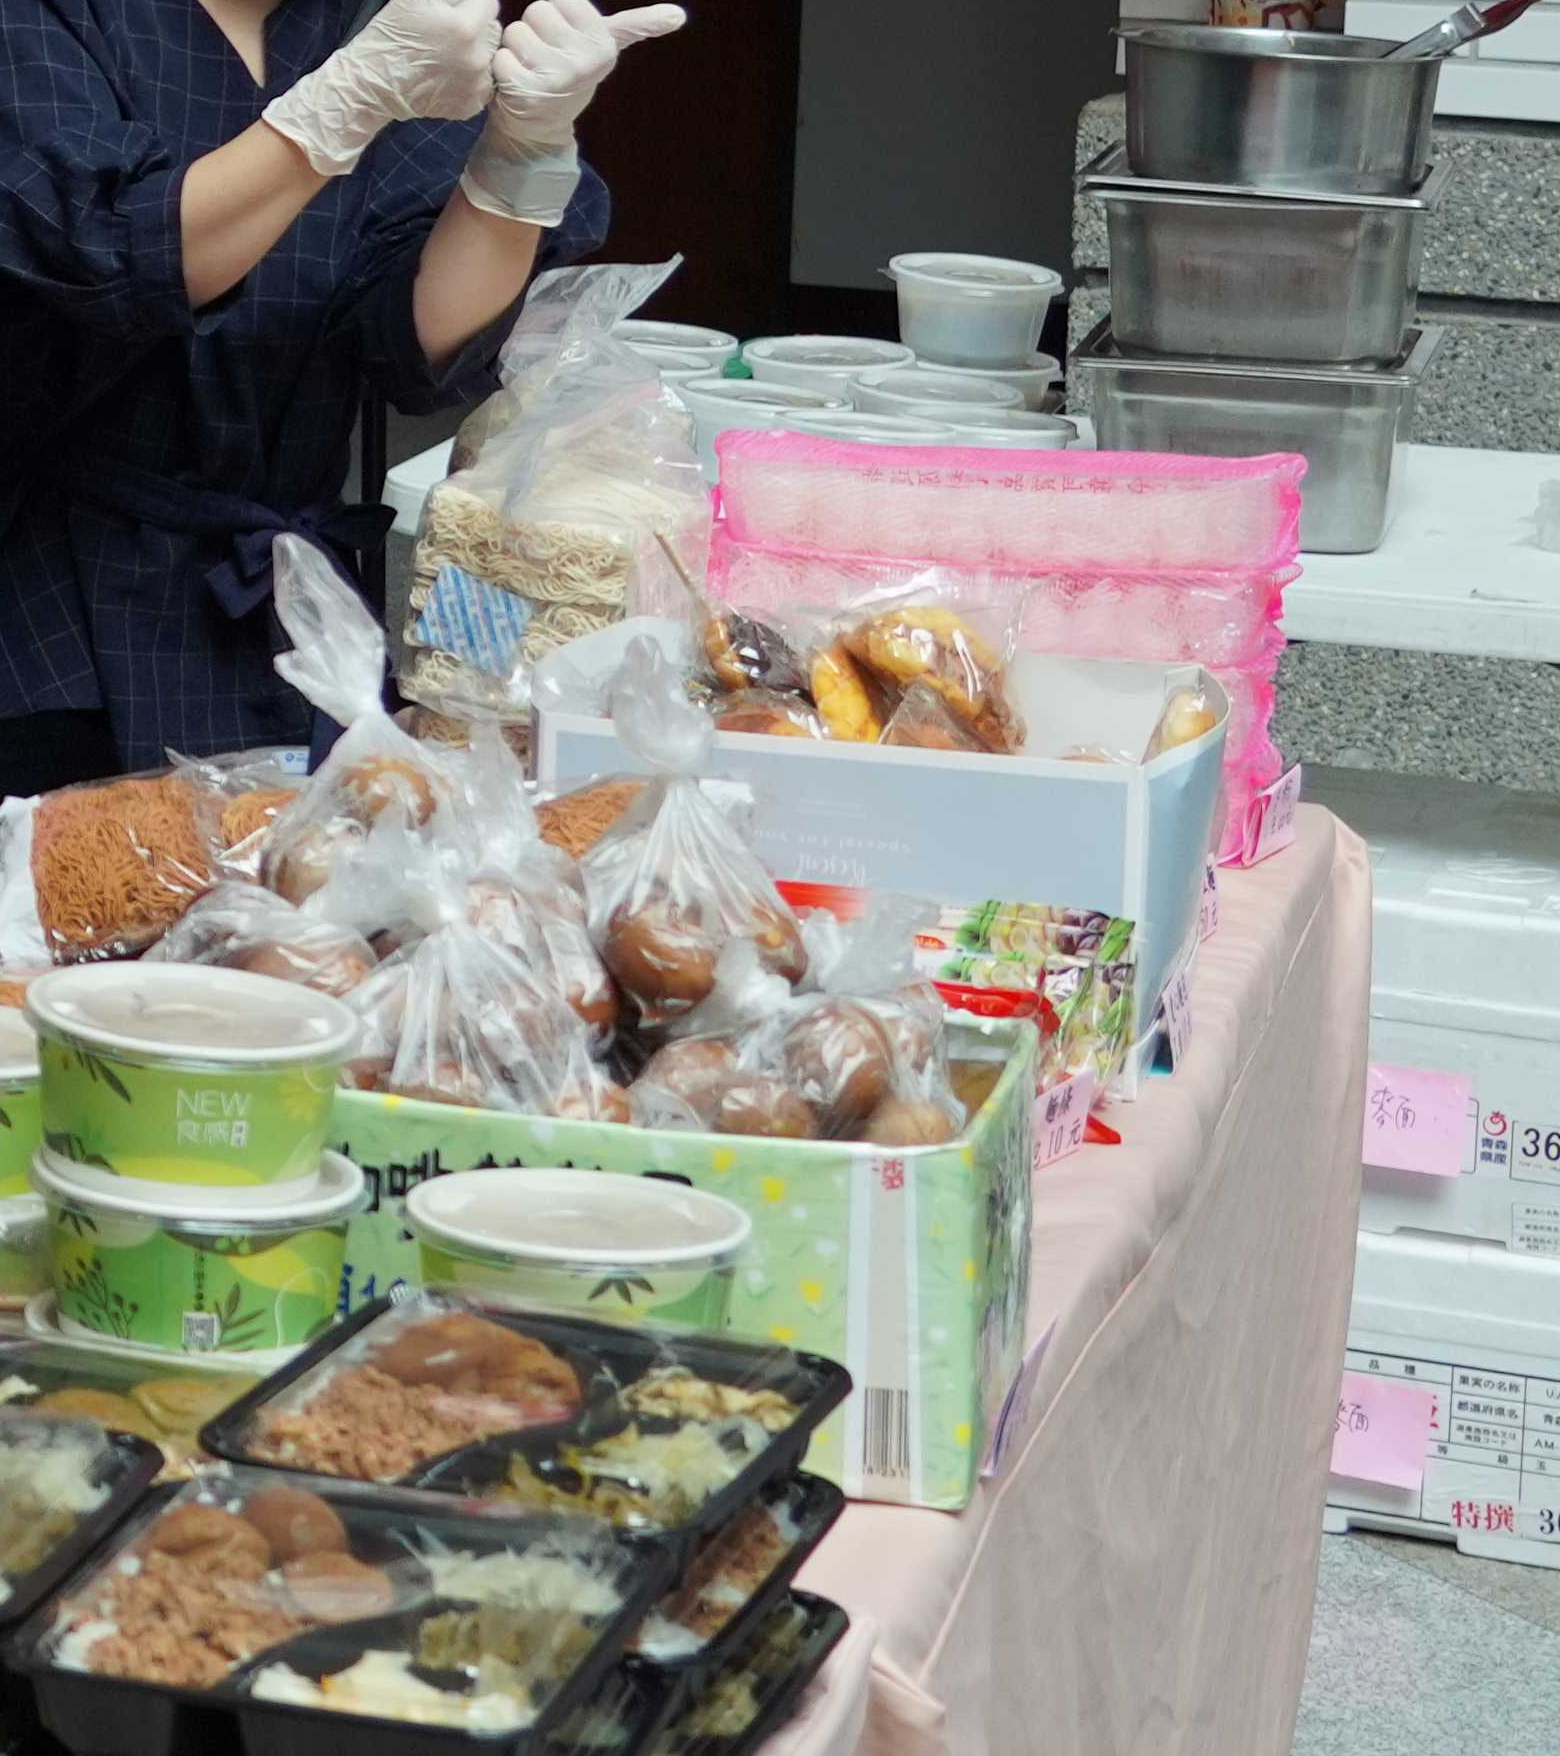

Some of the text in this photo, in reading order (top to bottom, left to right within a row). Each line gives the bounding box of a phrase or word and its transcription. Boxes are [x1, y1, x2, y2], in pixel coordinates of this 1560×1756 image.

[175, 1088, 252, 1118] NEW
[1521, 1127, 1560, 1162] 36
[1450, 1499, 1516, 1533] 特撰
